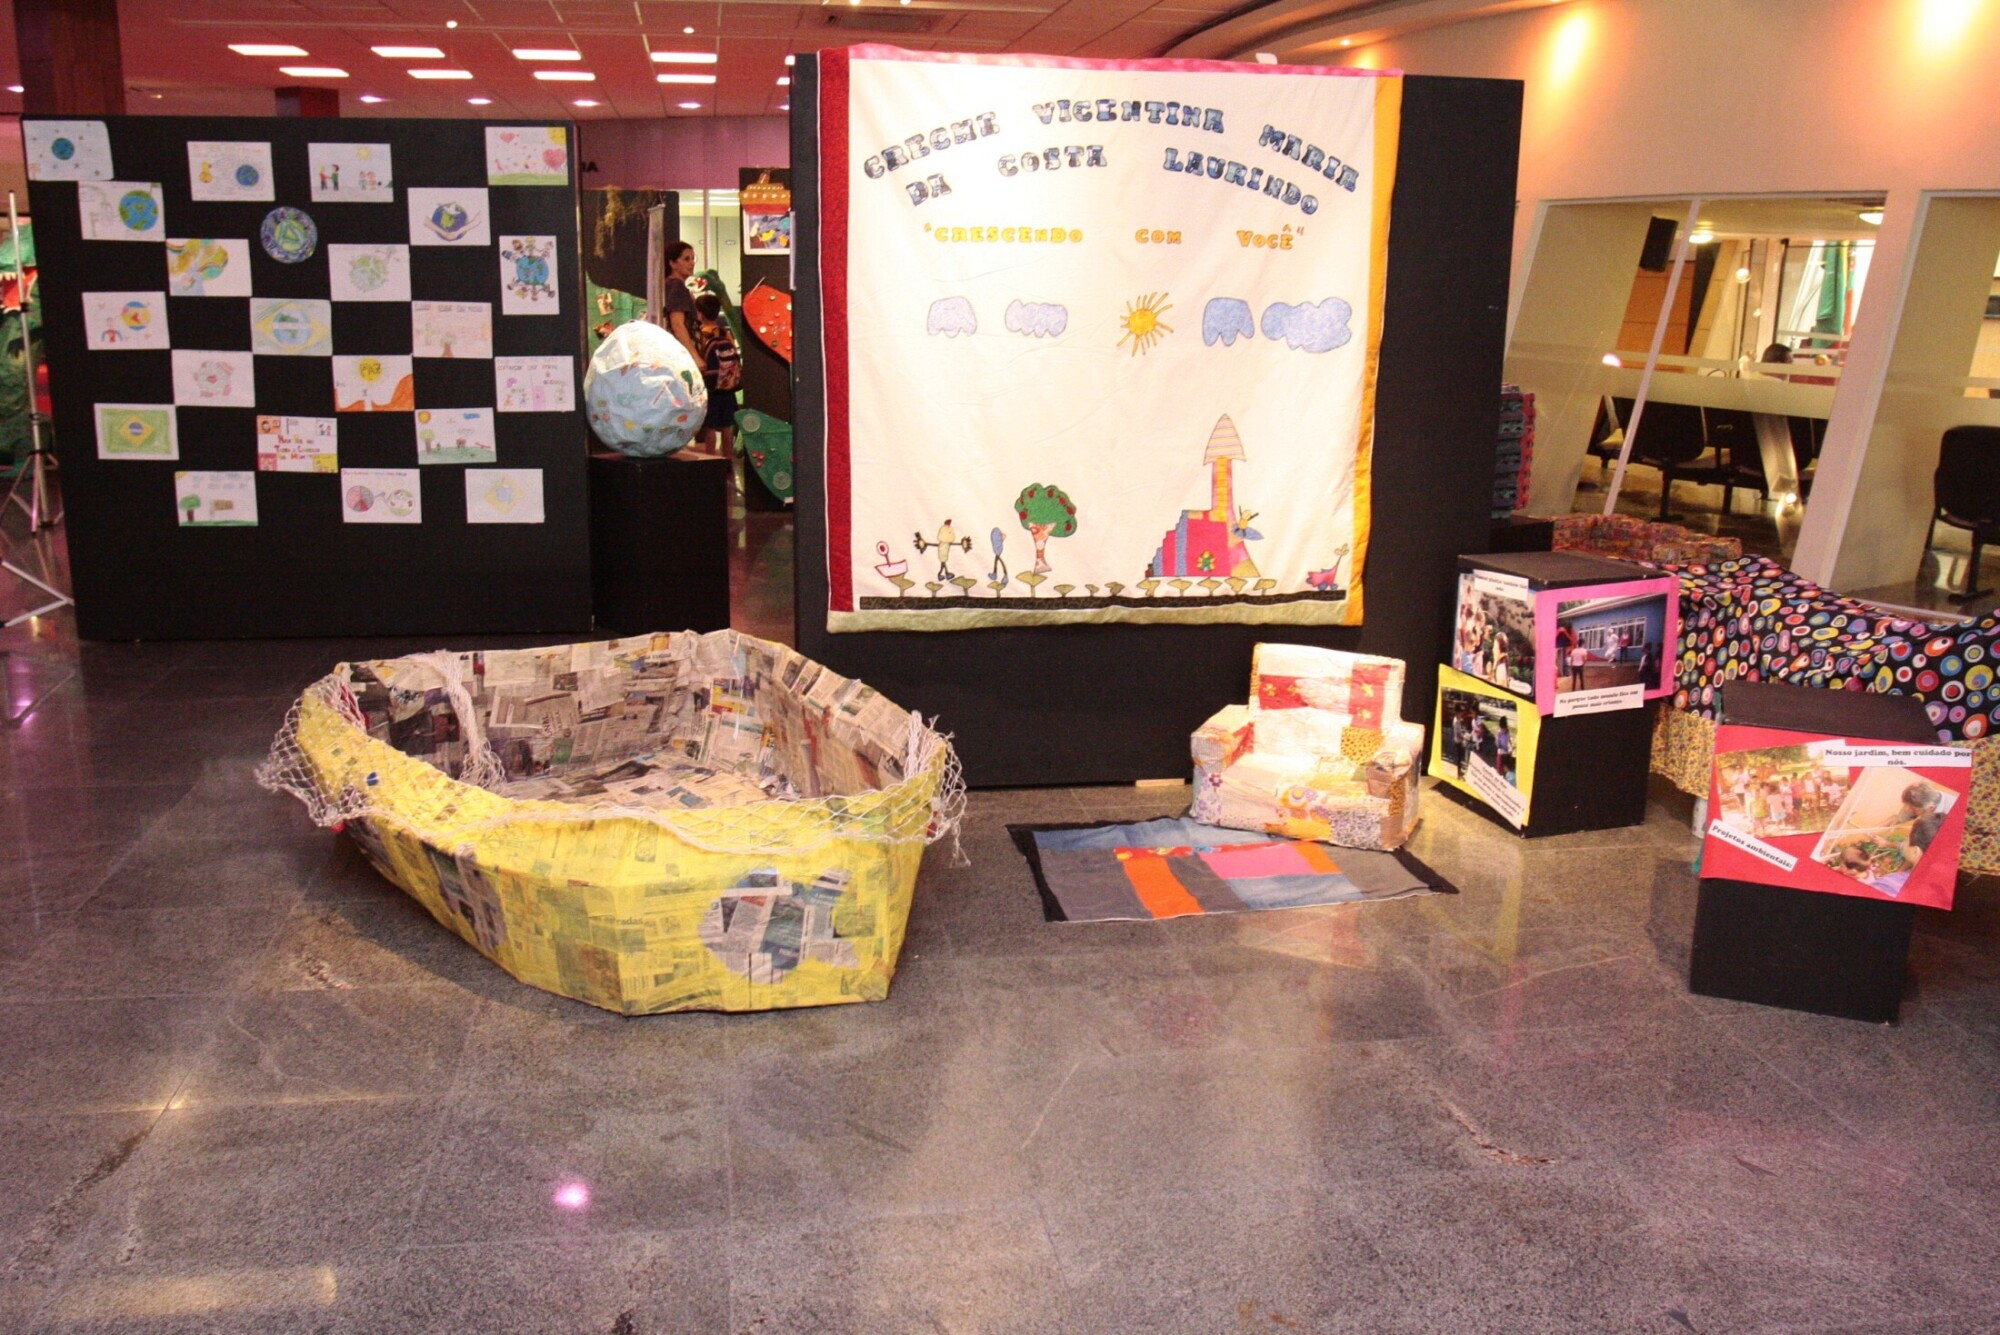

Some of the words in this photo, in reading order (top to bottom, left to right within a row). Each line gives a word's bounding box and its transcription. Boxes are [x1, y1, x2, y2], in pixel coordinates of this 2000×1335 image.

[864, 111, 1000, 179] CRECHE
[1032, 99, 1225, 134] VICENTINA
[1258, 124, 1360, 193] MARIA
[905, 173, 952, 206] DA
[998, 145, 1107, 177] COSTA
[1162, 147, 1319, 215] LAURINDO
[1135, 228, 1182, 245] COM
[1854, 749, 1889, 757] jardim,
[1712, 825, 1745, 845] Projetos
